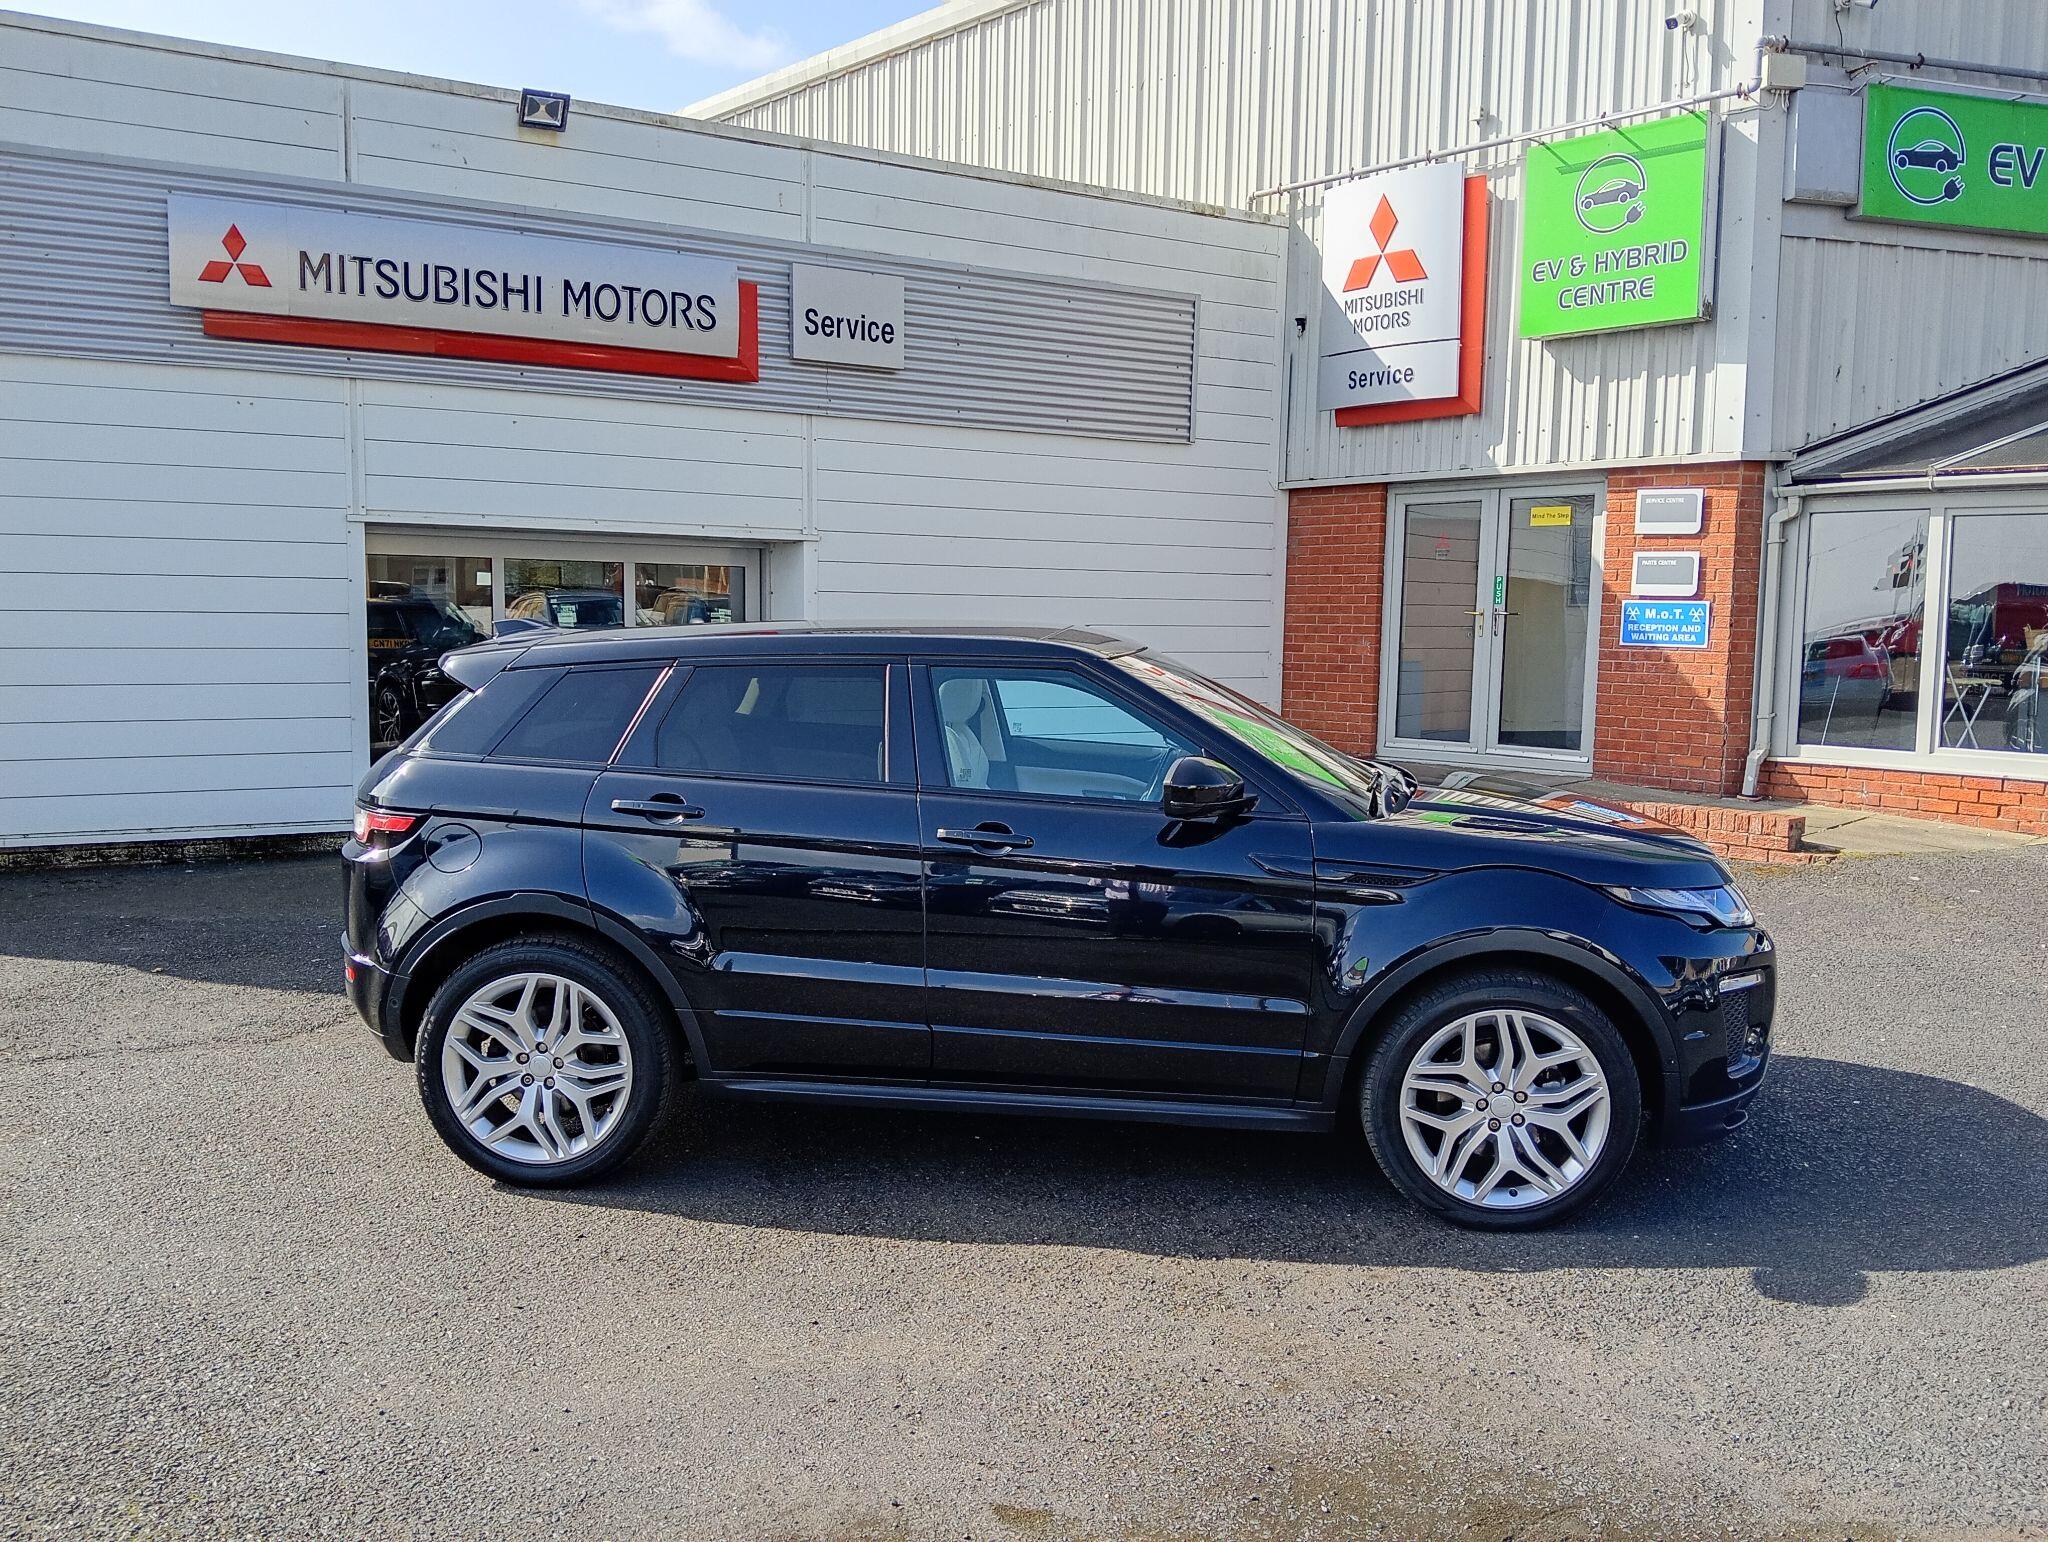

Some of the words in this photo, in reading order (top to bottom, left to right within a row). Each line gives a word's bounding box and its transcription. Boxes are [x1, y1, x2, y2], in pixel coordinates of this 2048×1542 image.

[1988, 143, 2046, 189] EV
[1531, 257, 1563, 284] EV
[1570, 256, 1587, 277] &
[1593, 238, 1689, 273] HYBRID
[298, 249, 544, 315] MITSUBISHI
[562, 278, 718, 334] MOTORS
[1343, 287, 1425, 317] MITSUBISHI
[1557, 276, 1656, 310] CENTRE
[803, 307, 897, 345] Service
[1352, 310, 1412, 334] MOTORS
[1347, 364, 1415, 390] Service
[1627, 623, 1679, 632] RECEPTION
[1681, 625, 1702, 633] AND
[1631, 633, 1670, 641] WAITING
[1672, 633, 1697, 642] AREA
